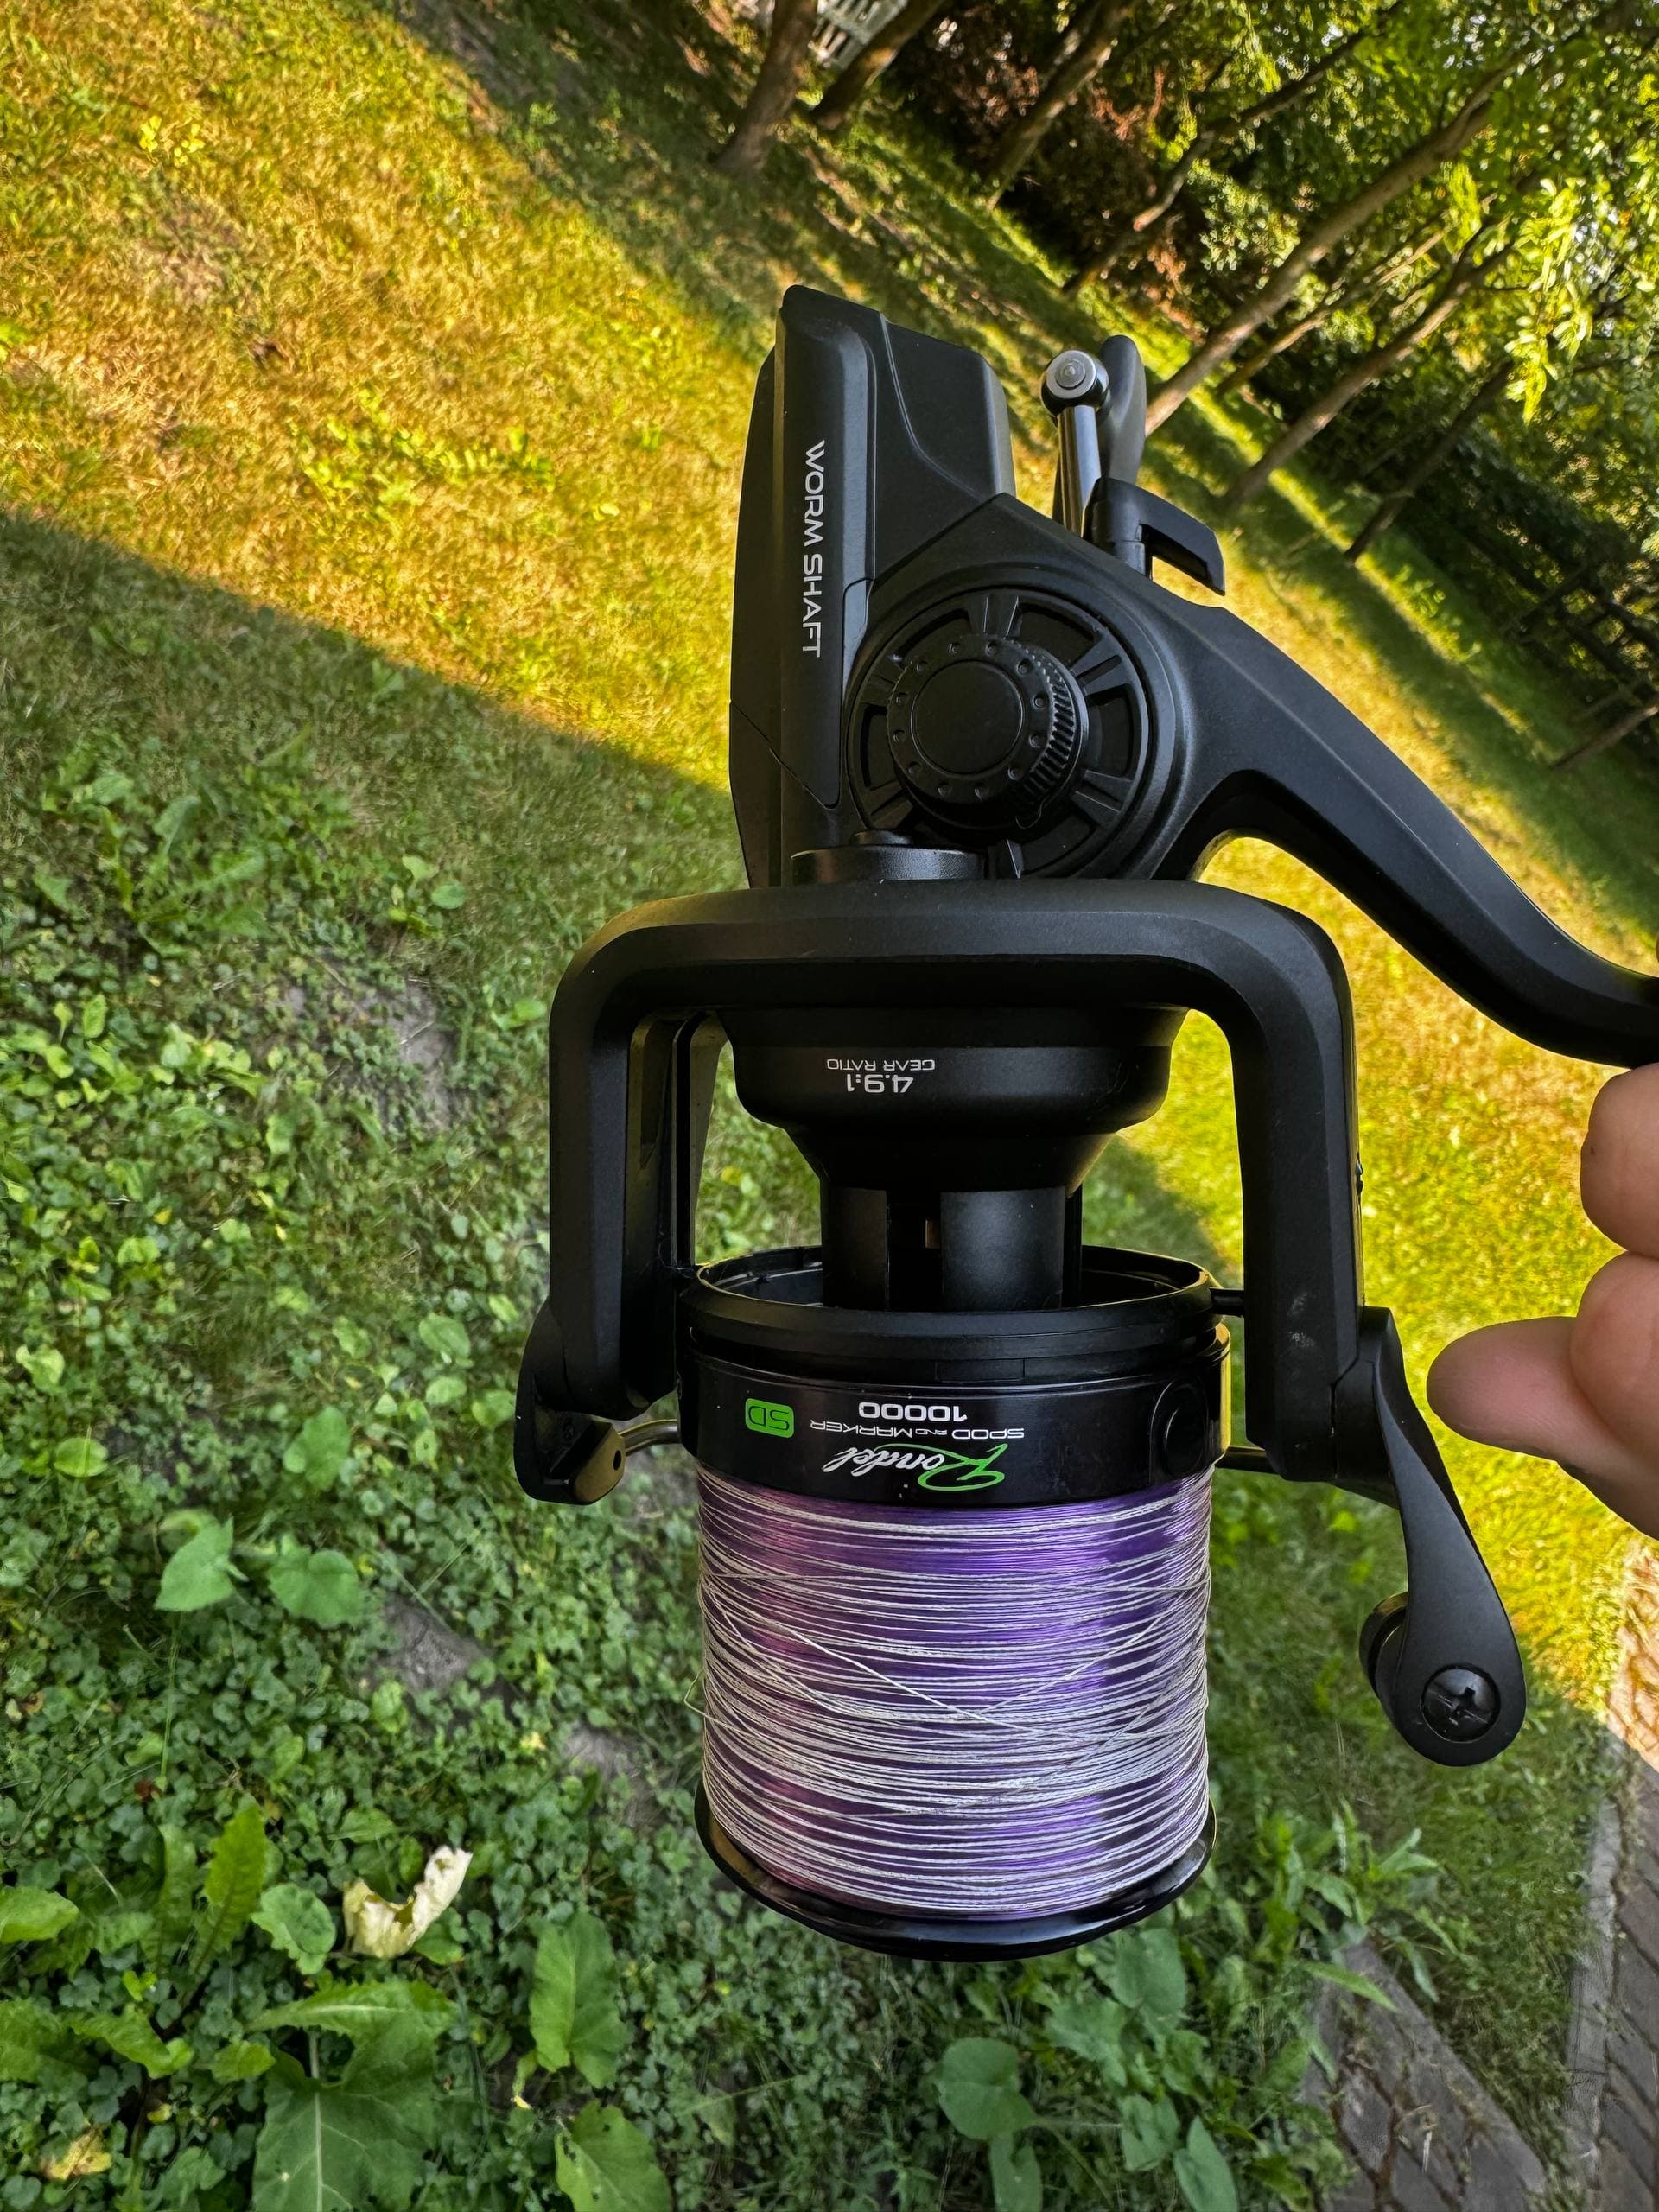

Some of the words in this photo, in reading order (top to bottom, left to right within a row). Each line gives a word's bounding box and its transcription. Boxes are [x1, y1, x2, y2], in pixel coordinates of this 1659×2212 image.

[804, 439, 825, 547] WORM
[802, 553, 823, 658] SHAFT
[826, 1058, 877, 1071] RATIO
[883, 1059, 936, 1071] GEAR
[846, 1073, 914, 1093] 4.9:1
[748, 1405, 790, 1431] SD
[858, 1402, 968, 1422] 10000
[810, 1419, 912, 1439] MARKER
[951, 1427, 1025, 1440] SPOD
[822, 1443, 1009, 1491] Rondel
